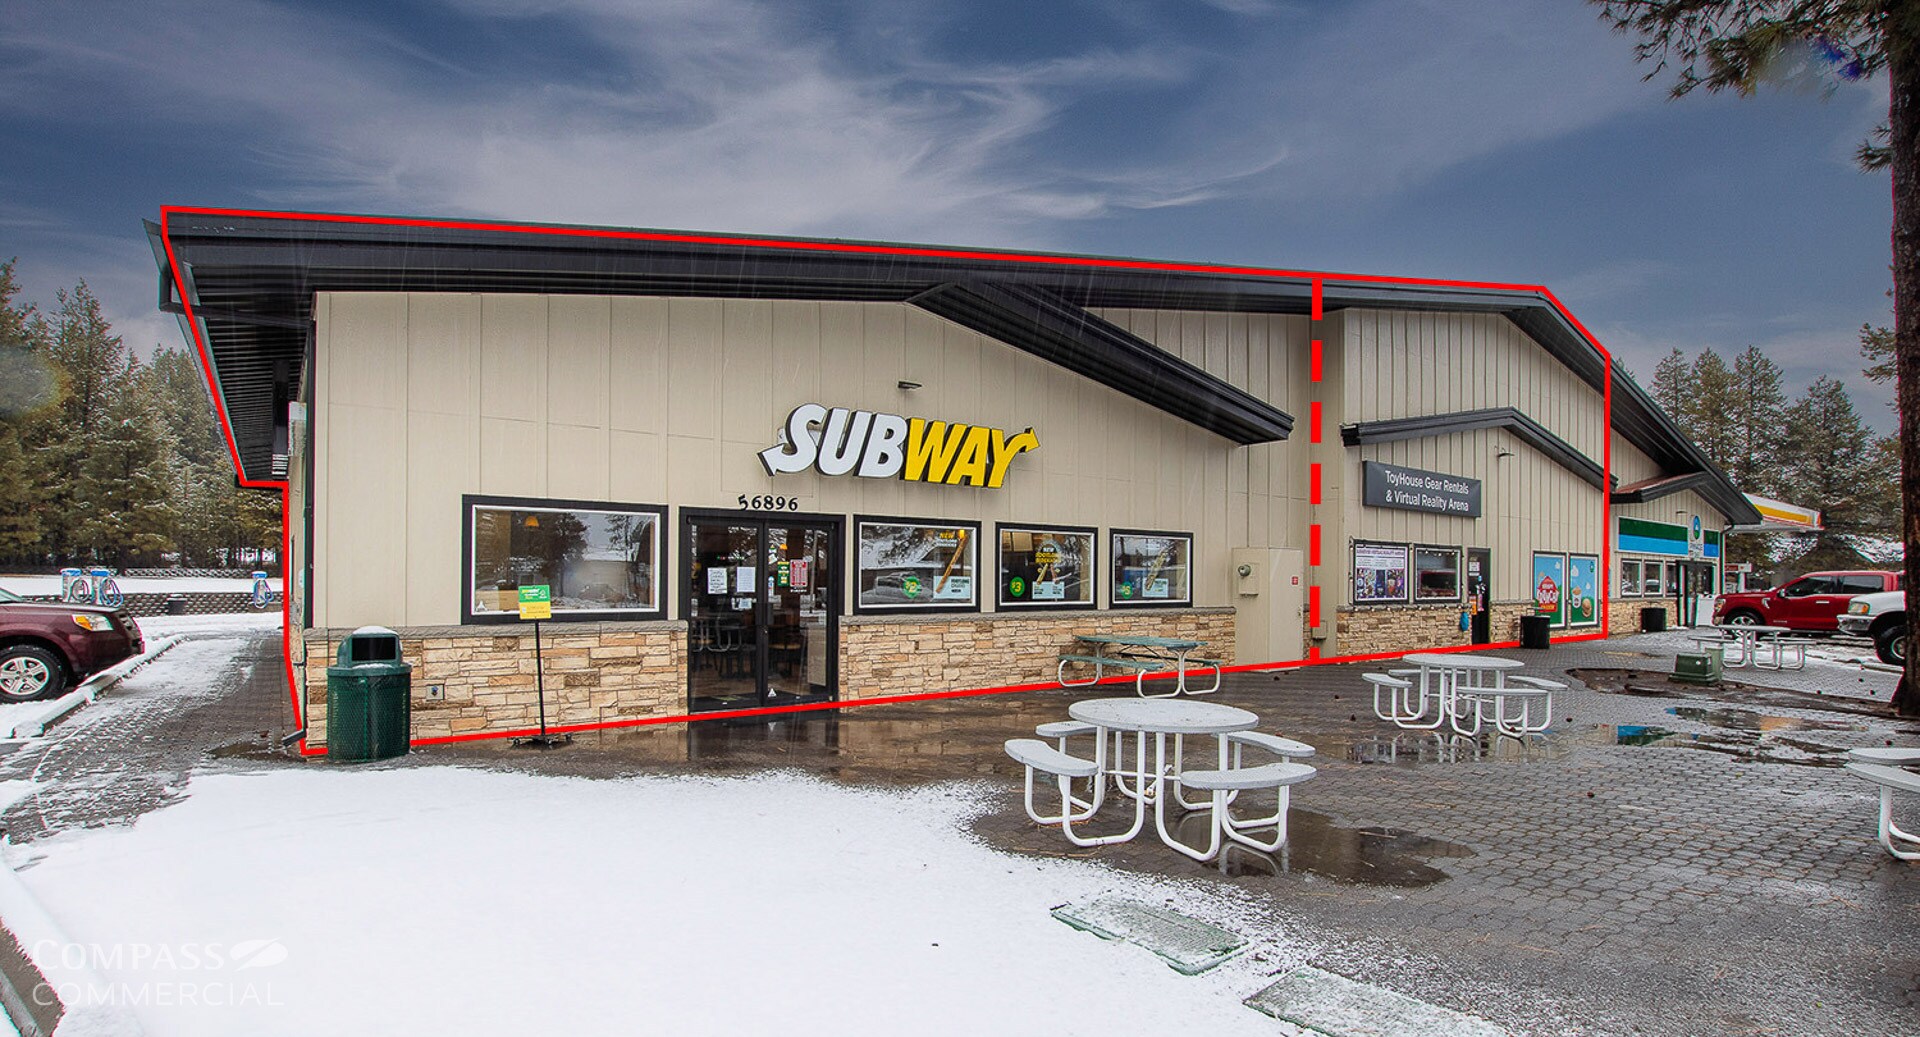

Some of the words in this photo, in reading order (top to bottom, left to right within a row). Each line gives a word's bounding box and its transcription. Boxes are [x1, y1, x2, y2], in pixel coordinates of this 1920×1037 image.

[758, 403, 1040, 488] SUBWAY
[1385, 470, 1423, 488] ToyHouse
[1425, 476, 1442, 490] Gear
[1443, 480, 1469, 495] Rentals
[738, 494, 798, 511] 56896
[1385, 489, 1393, 502] &
[1394, 491, 1420, 506] Virtual
[1421, 494, 1448, 512] Reality
[1448, 498, 1469, 512] Arena
[1011, 581, 1022, 593] $3
